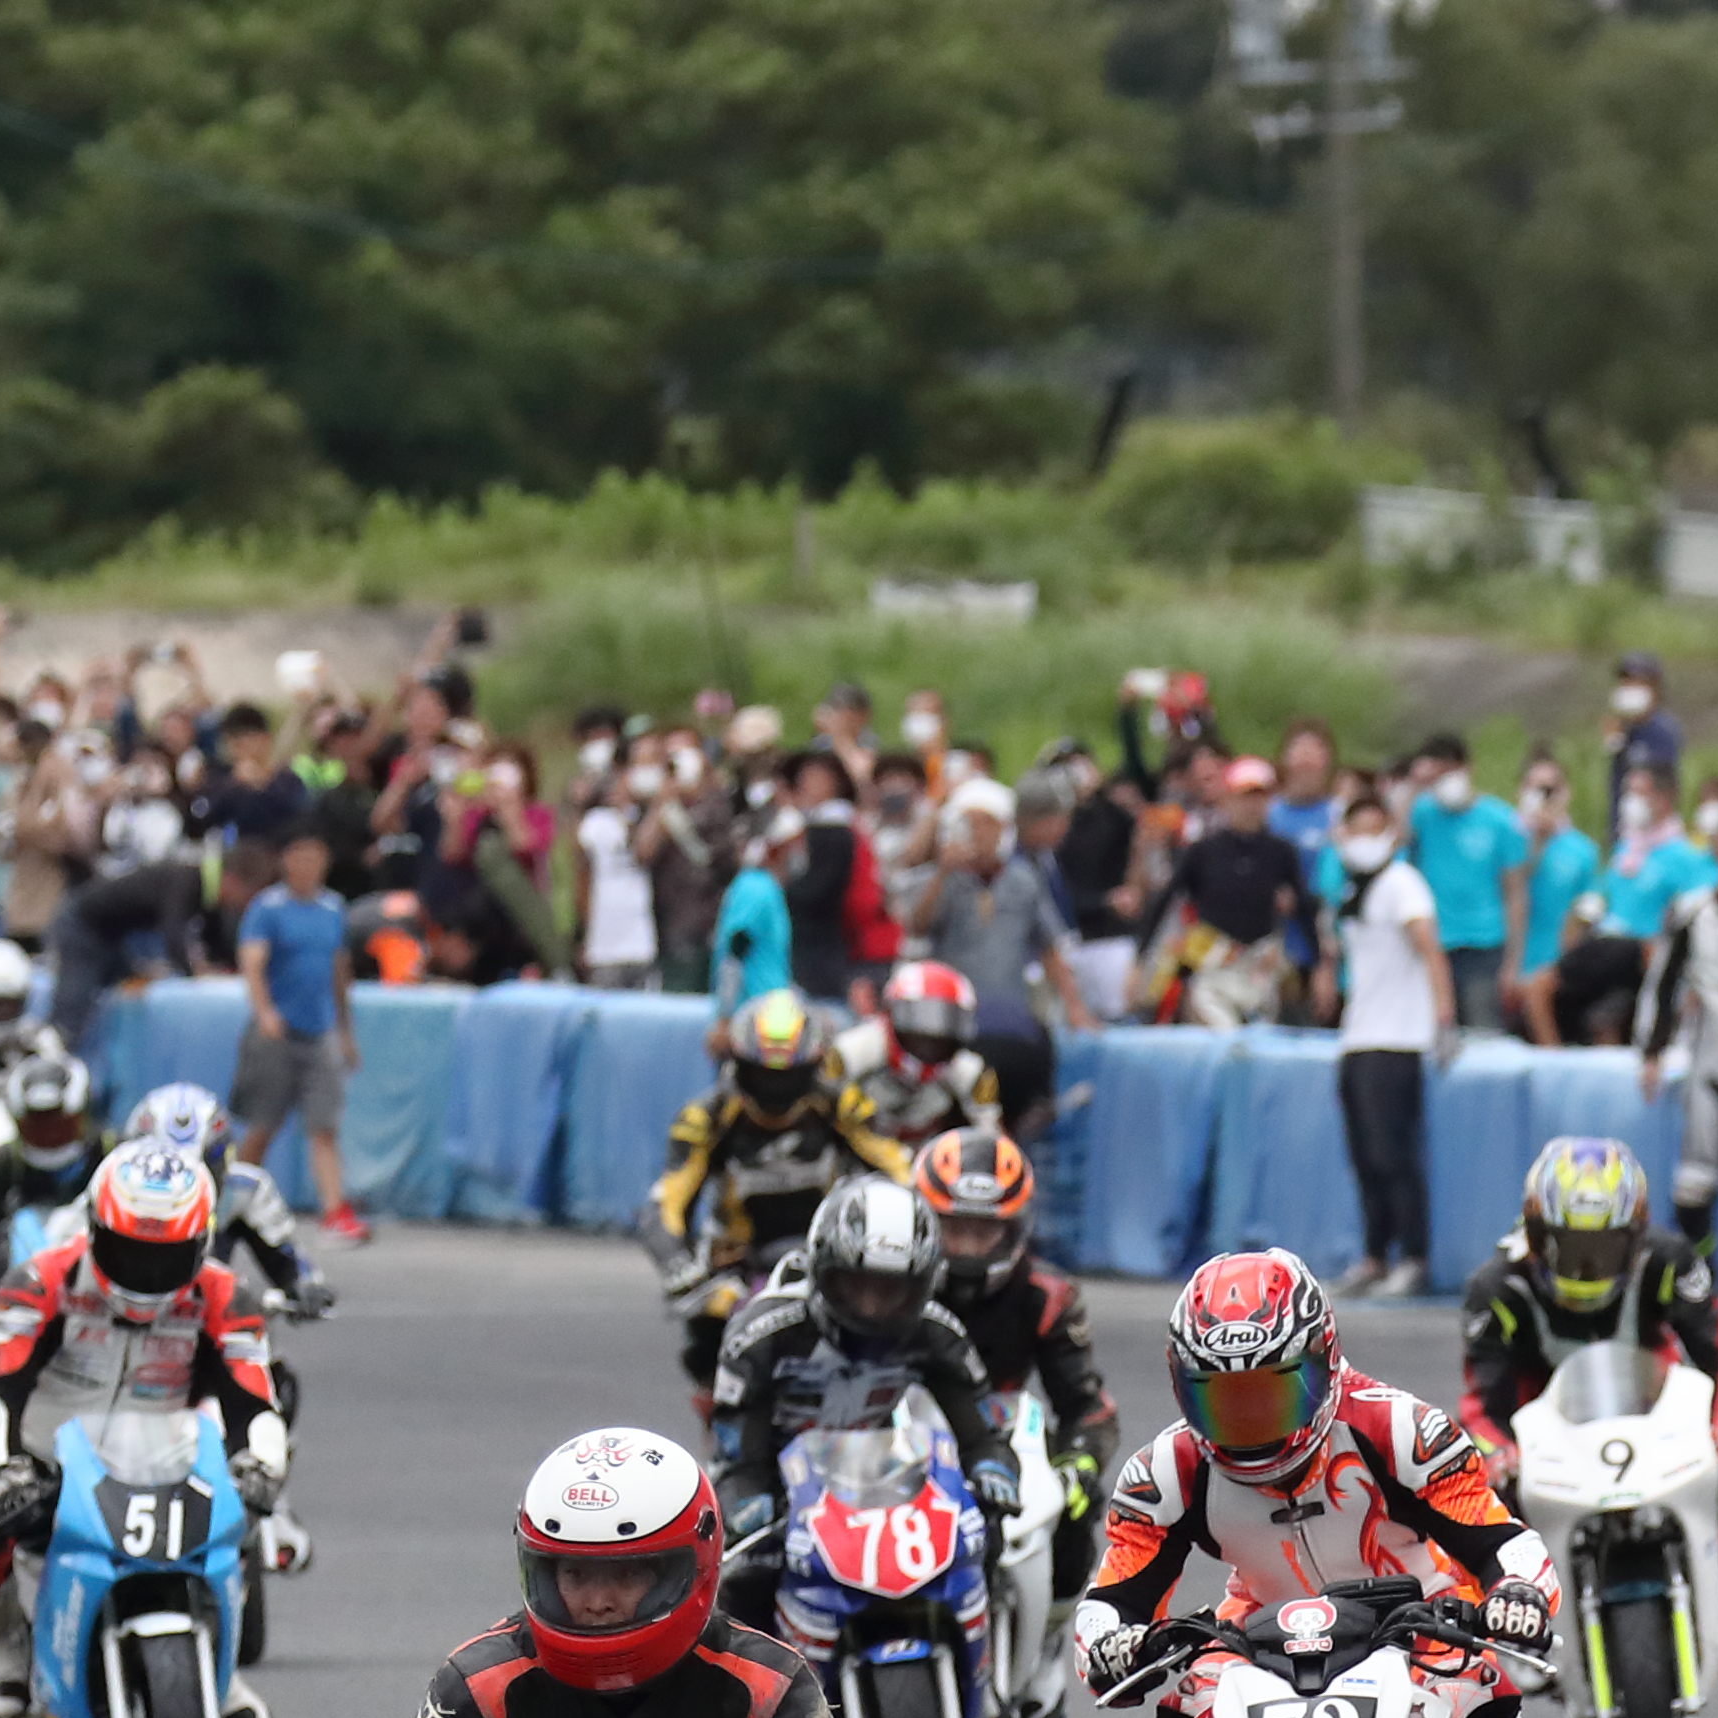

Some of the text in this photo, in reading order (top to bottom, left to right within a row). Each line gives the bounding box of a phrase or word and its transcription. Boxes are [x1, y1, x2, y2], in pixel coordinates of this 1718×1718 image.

[1207, 1326, 1261, 1347] Arai
[1600, 1439, 1634, 1484] 9
[567, 1488, 613, 1503] BELL
[122, 1494, 184, 1560] 51
[846, 1504, 937, 1589] 78
